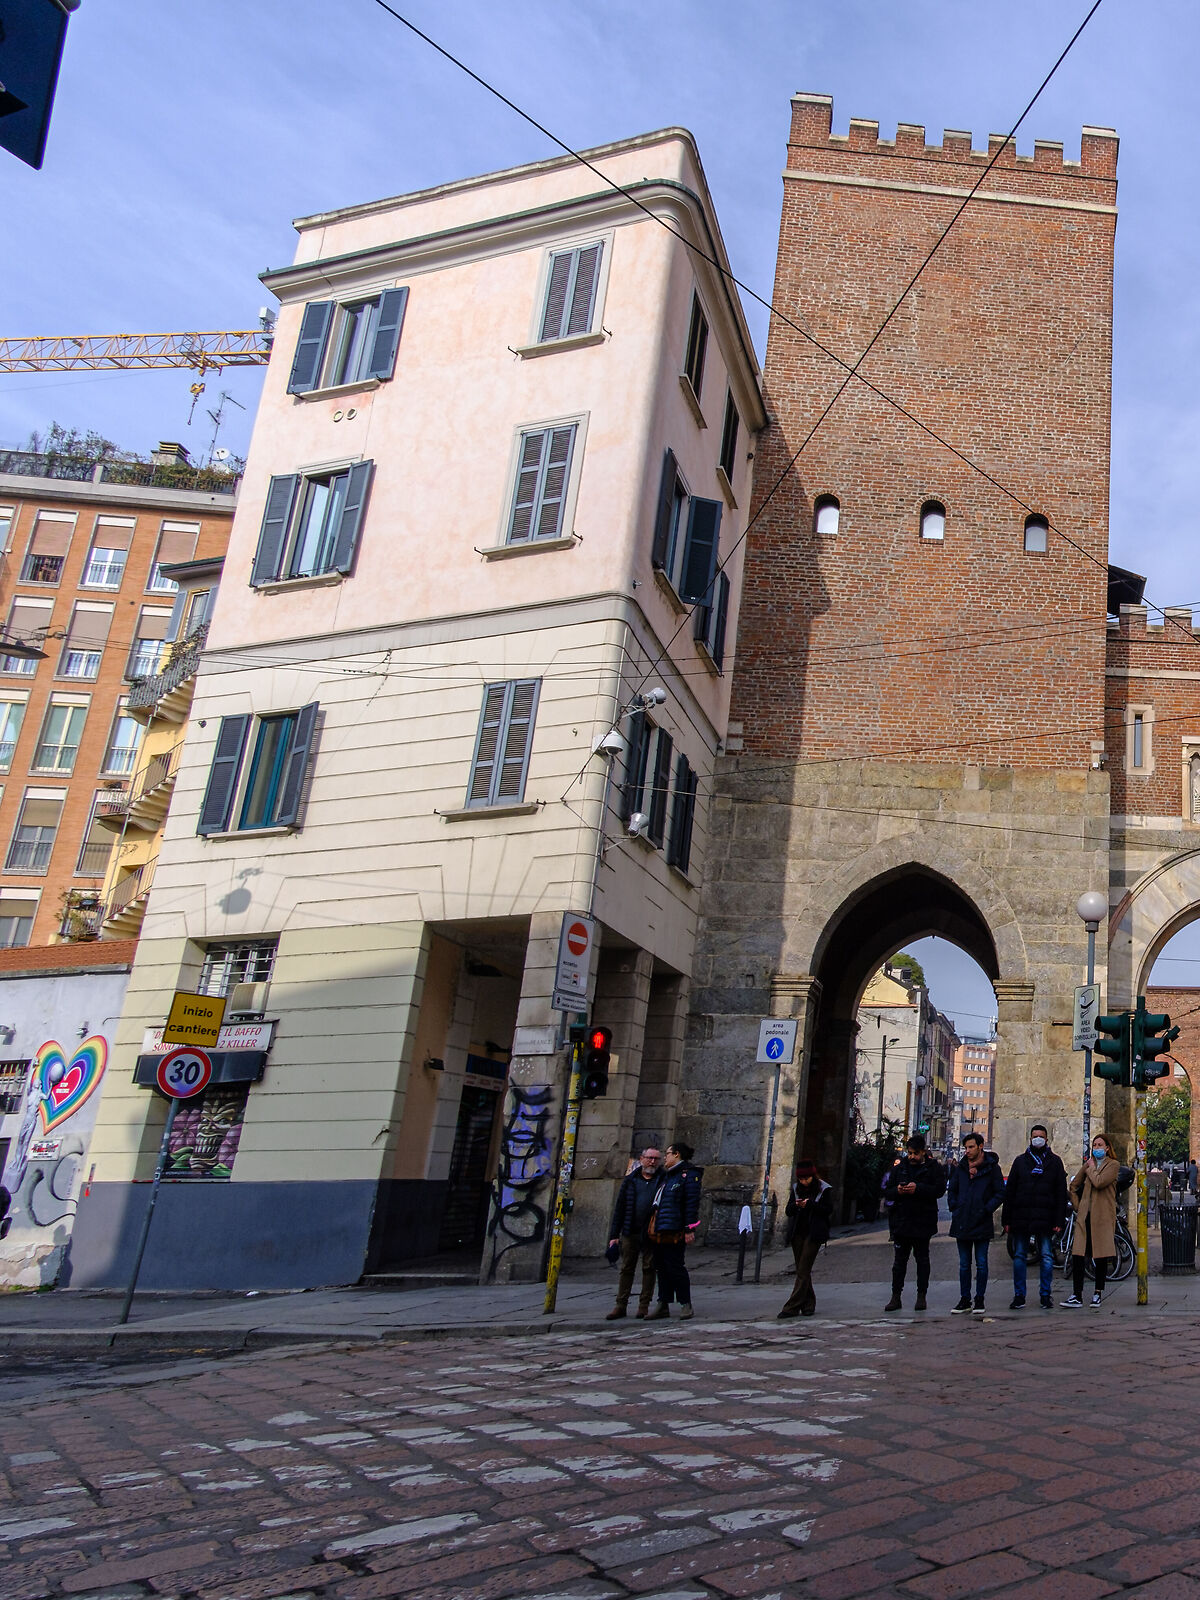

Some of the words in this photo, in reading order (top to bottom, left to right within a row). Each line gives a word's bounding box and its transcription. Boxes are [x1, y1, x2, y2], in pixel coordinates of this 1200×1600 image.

[183, 1005, 214, 1018] inizio
[168, 1024, 218, 1037] cantiere
[223, 1027, 233, 1037] IL
[234, 1027, 262, 1037] BAFFO
[227, 1039, 258, 1048] KILLER
[169, 1060, 201, 1085] 30
